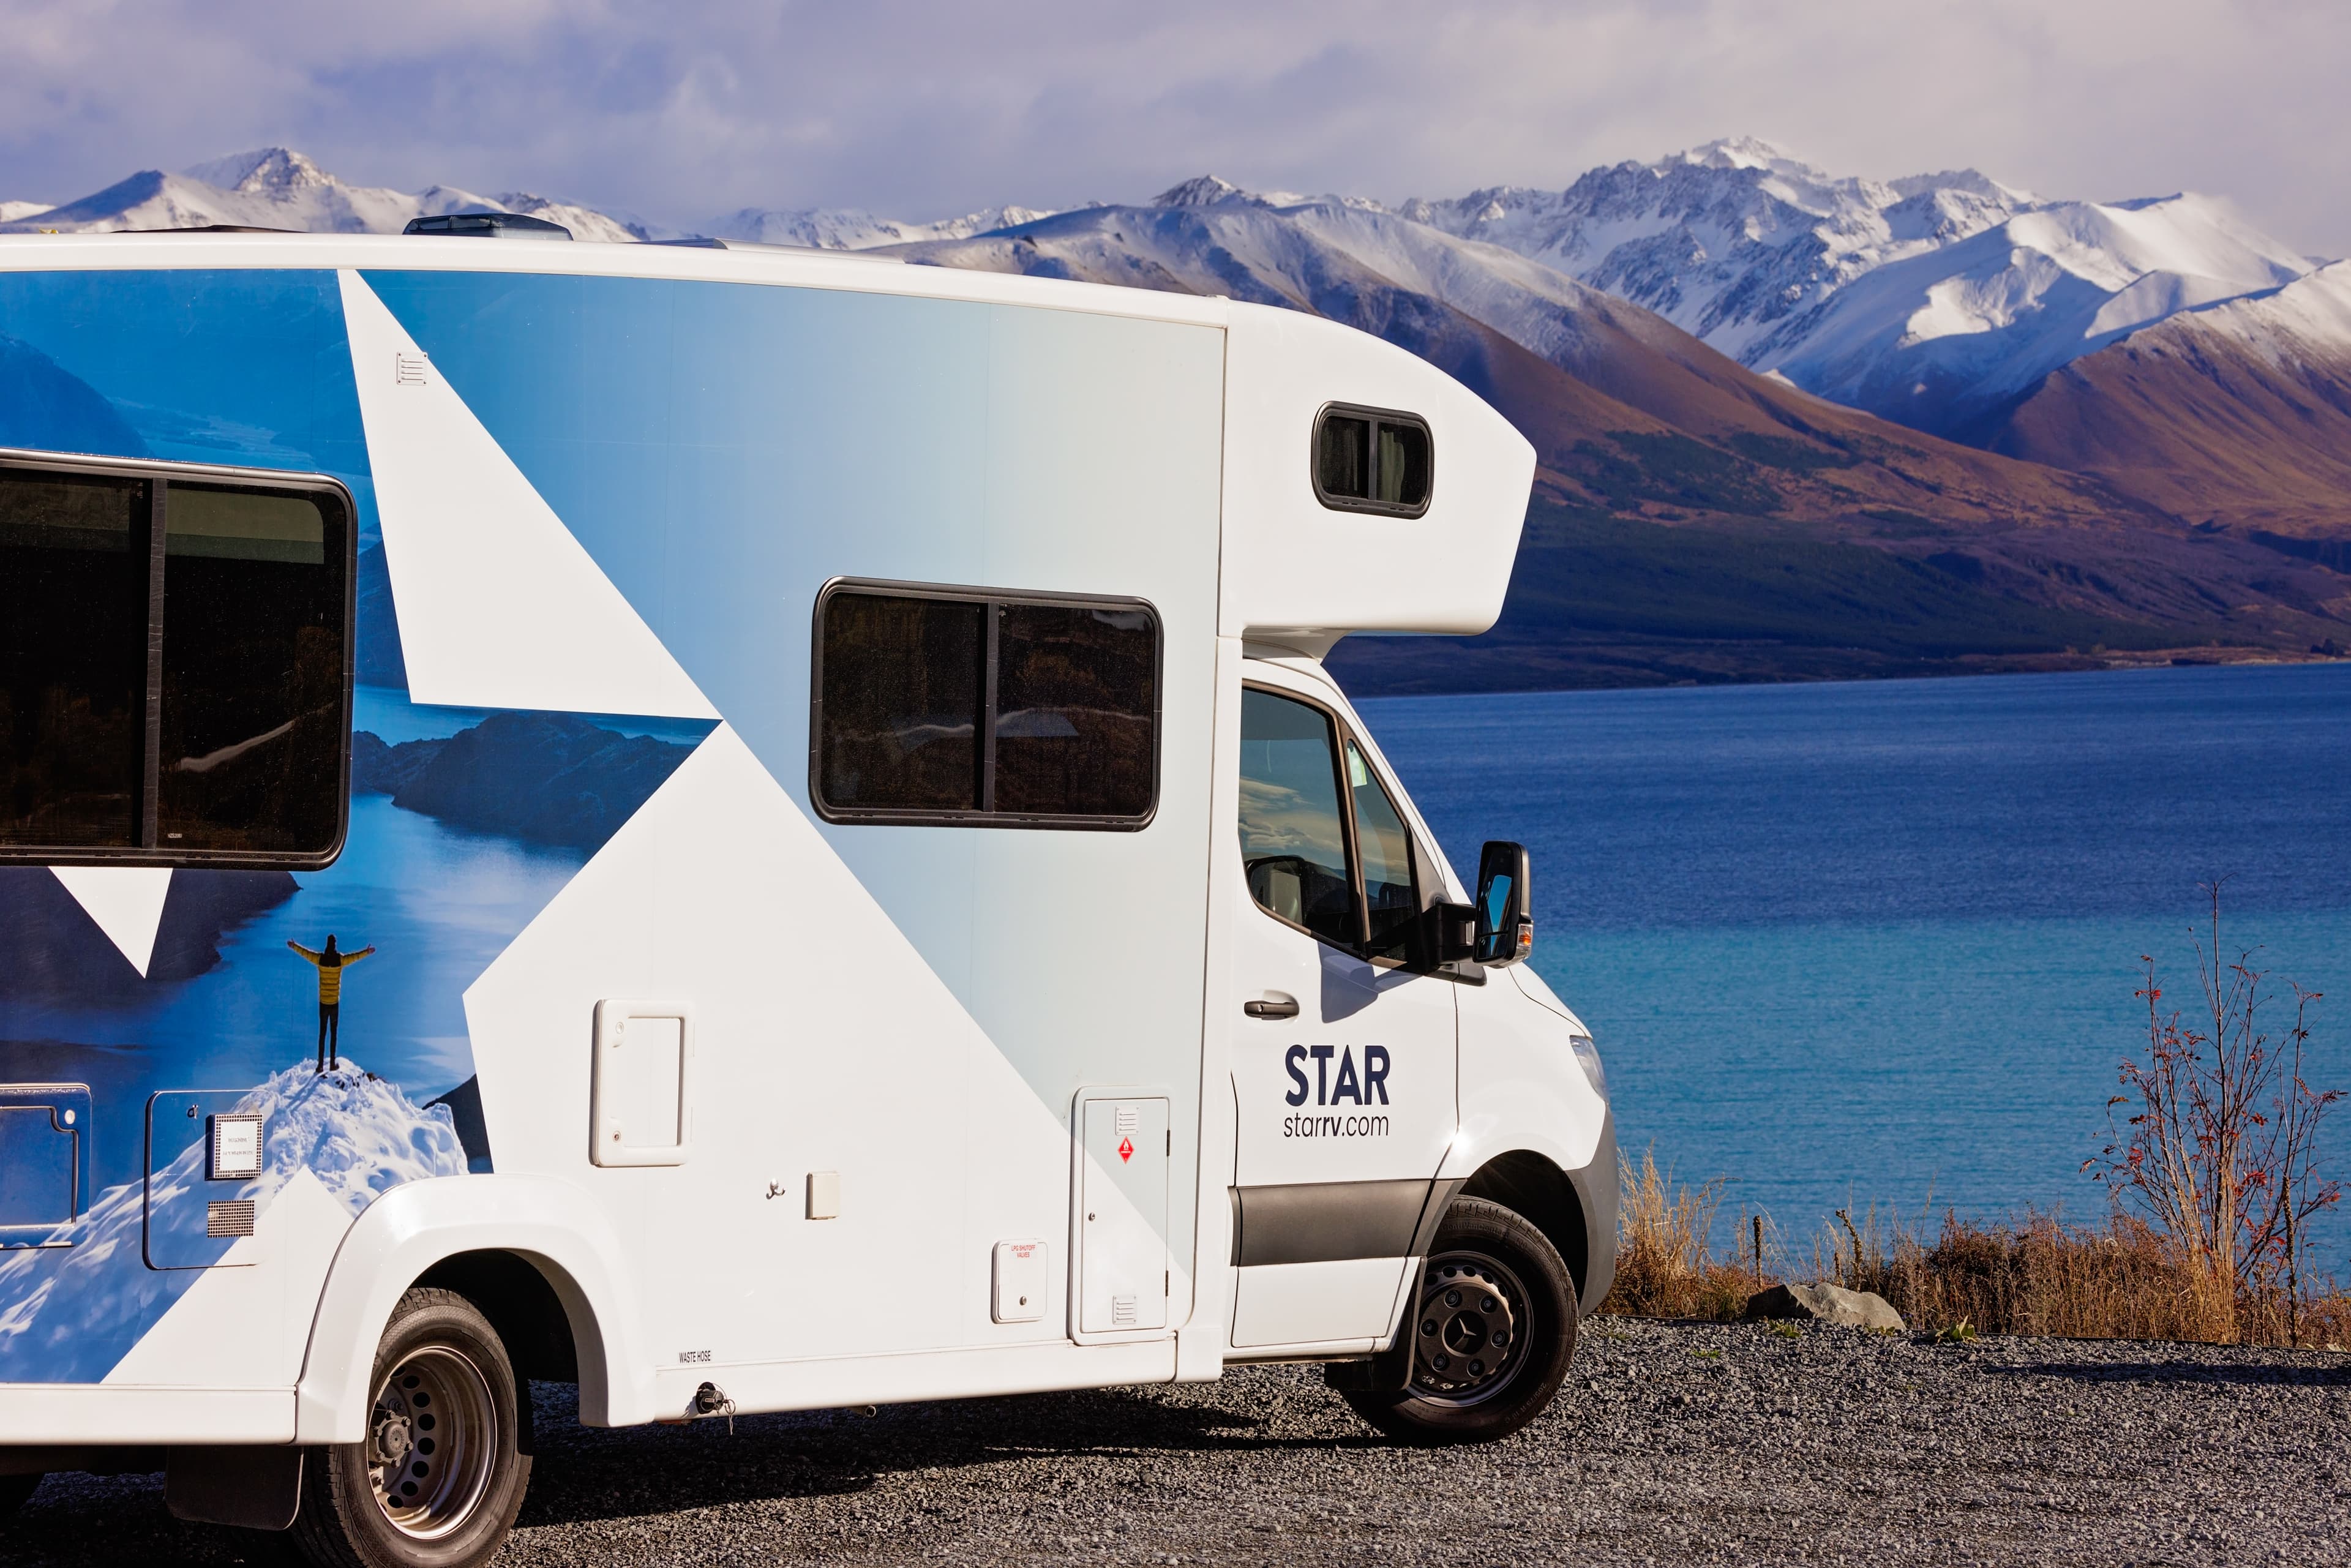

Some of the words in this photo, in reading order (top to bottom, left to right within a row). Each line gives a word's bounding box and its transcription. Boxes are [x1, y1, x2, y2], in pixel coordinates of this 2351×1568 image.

[1285, 1045, 1390, 1106] STAR
[1284, 1112, 1389, 1138] starrv.com
[679, 1351, 696, 1364] WASTE
[697, 1350, 711, 1362] HOSE
